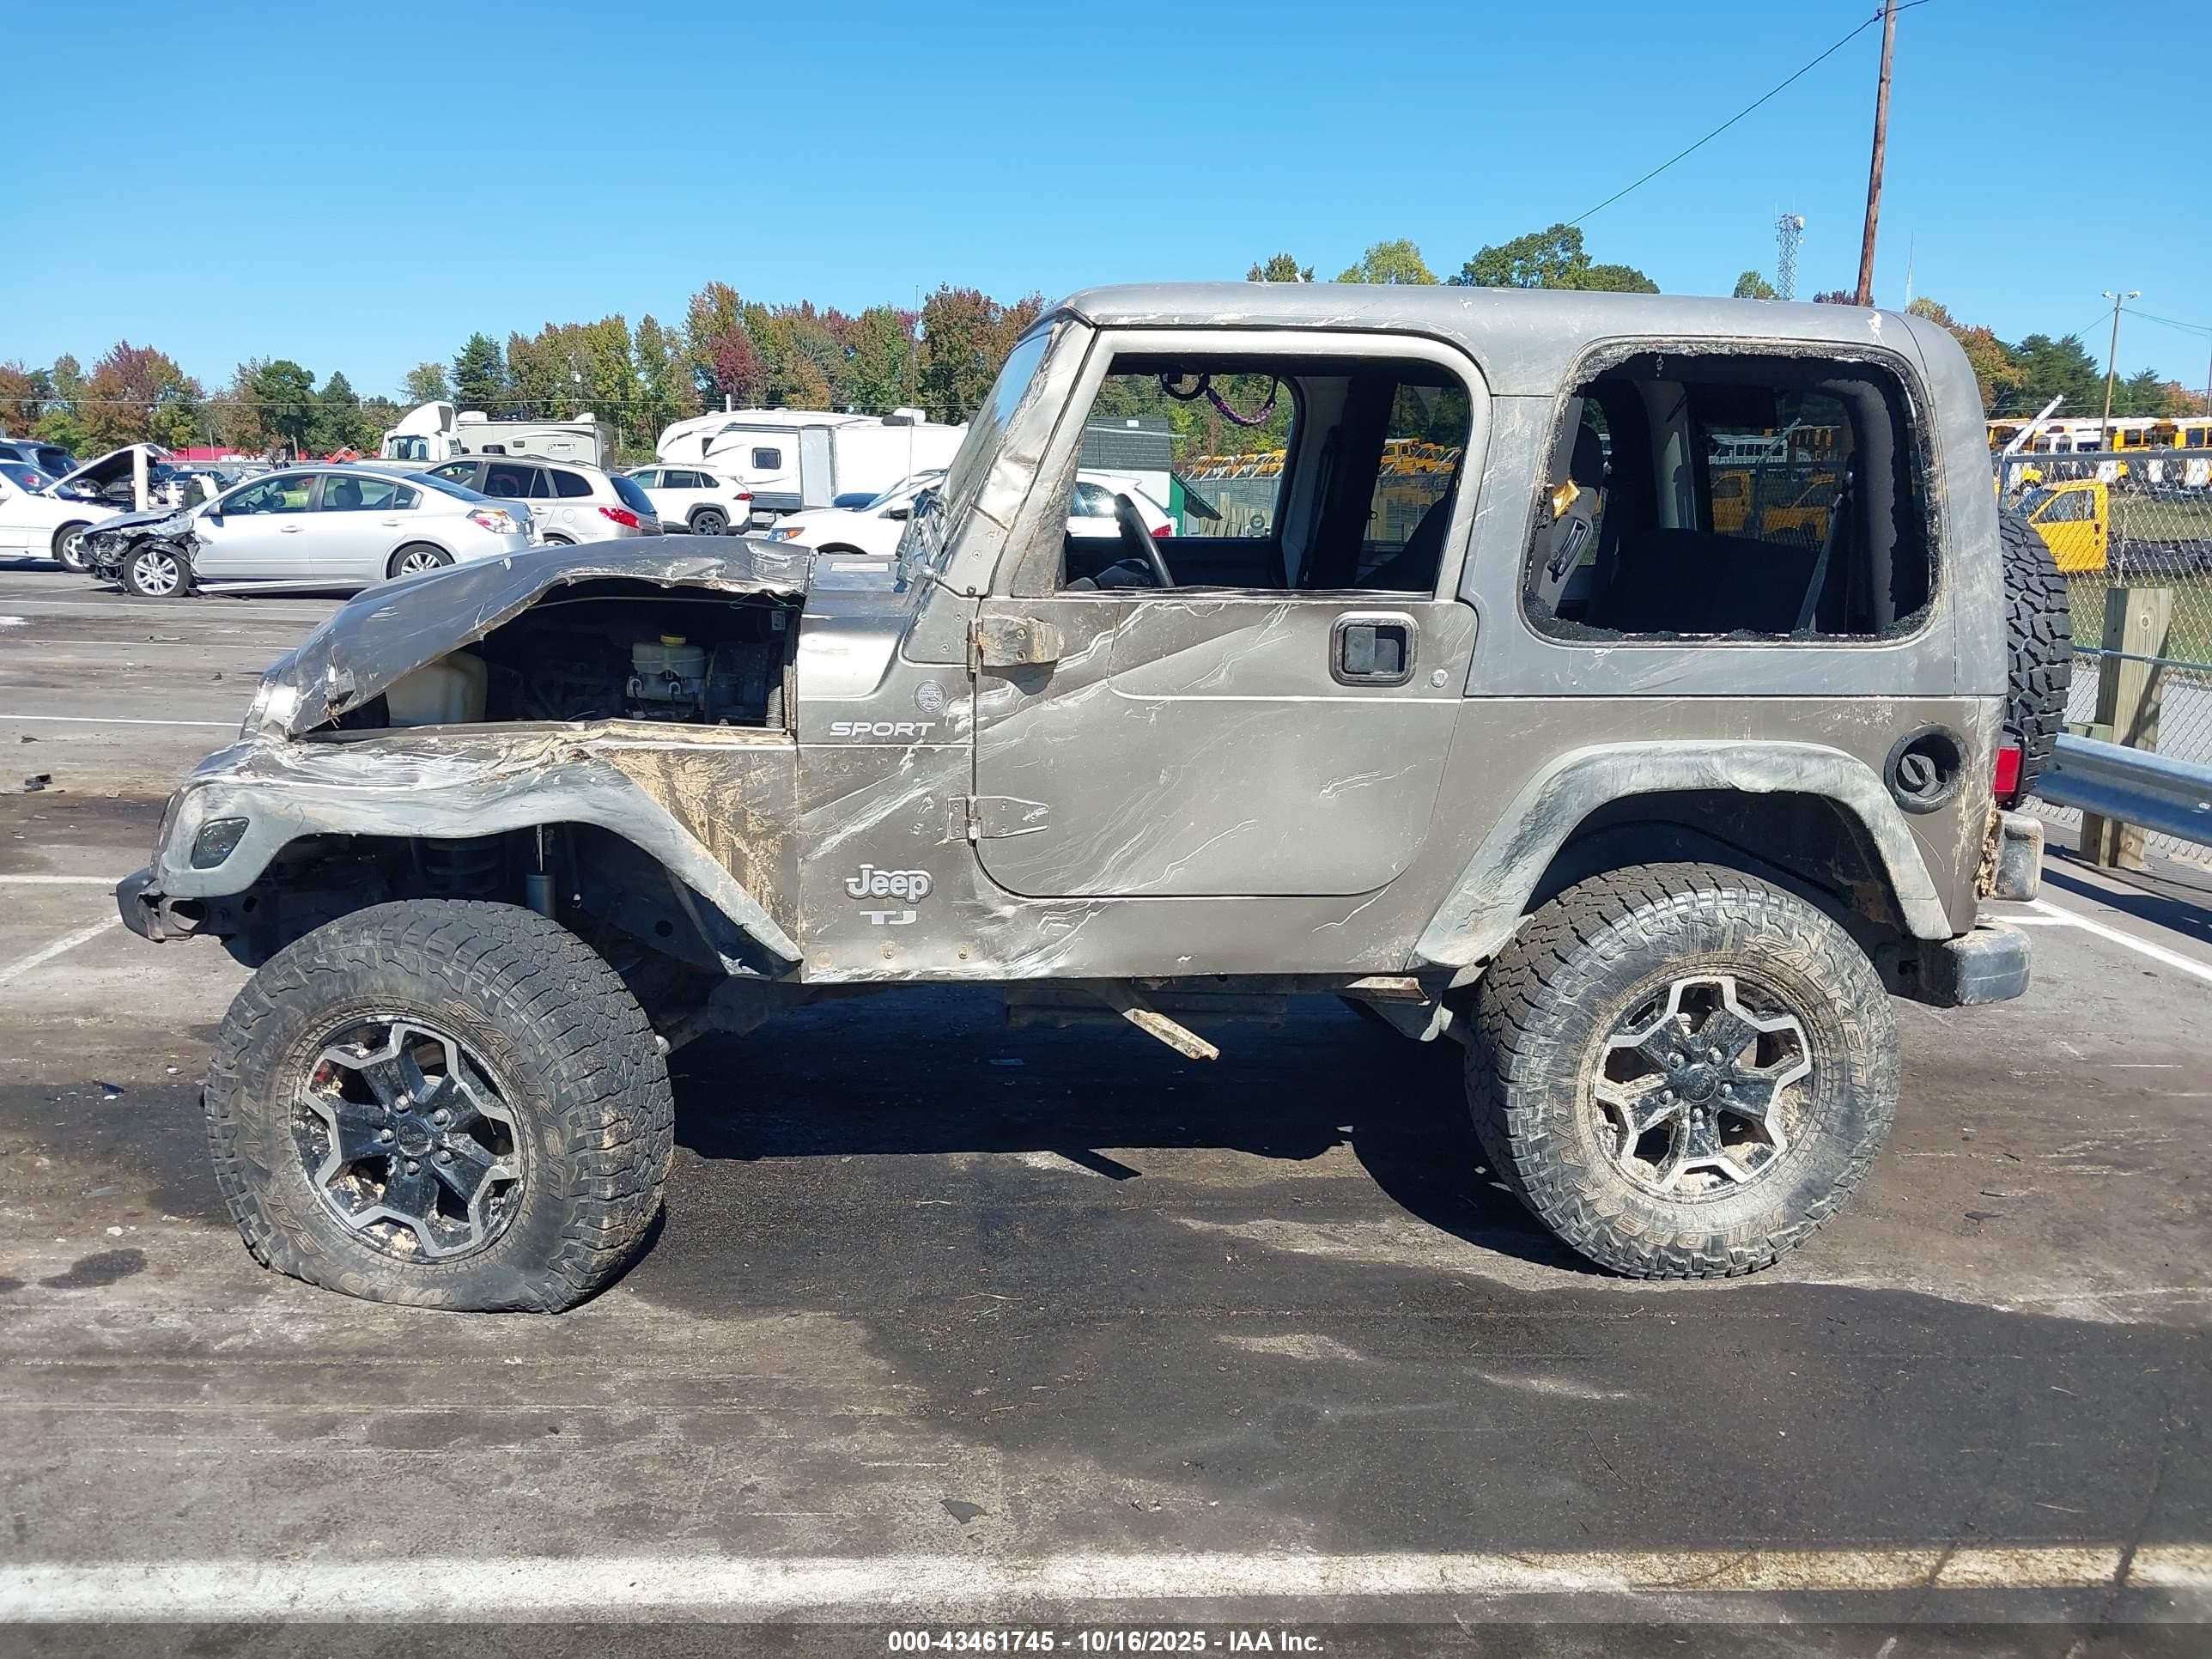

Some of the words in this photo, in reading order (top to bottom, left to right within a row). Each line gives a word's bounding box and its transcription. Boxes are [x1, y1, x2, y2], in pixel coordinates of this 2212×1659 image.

[830, 722, 935, 737] SPORT
[846, 864, 933, 902] Jeep
[860, 910, 917, 925] TJ
